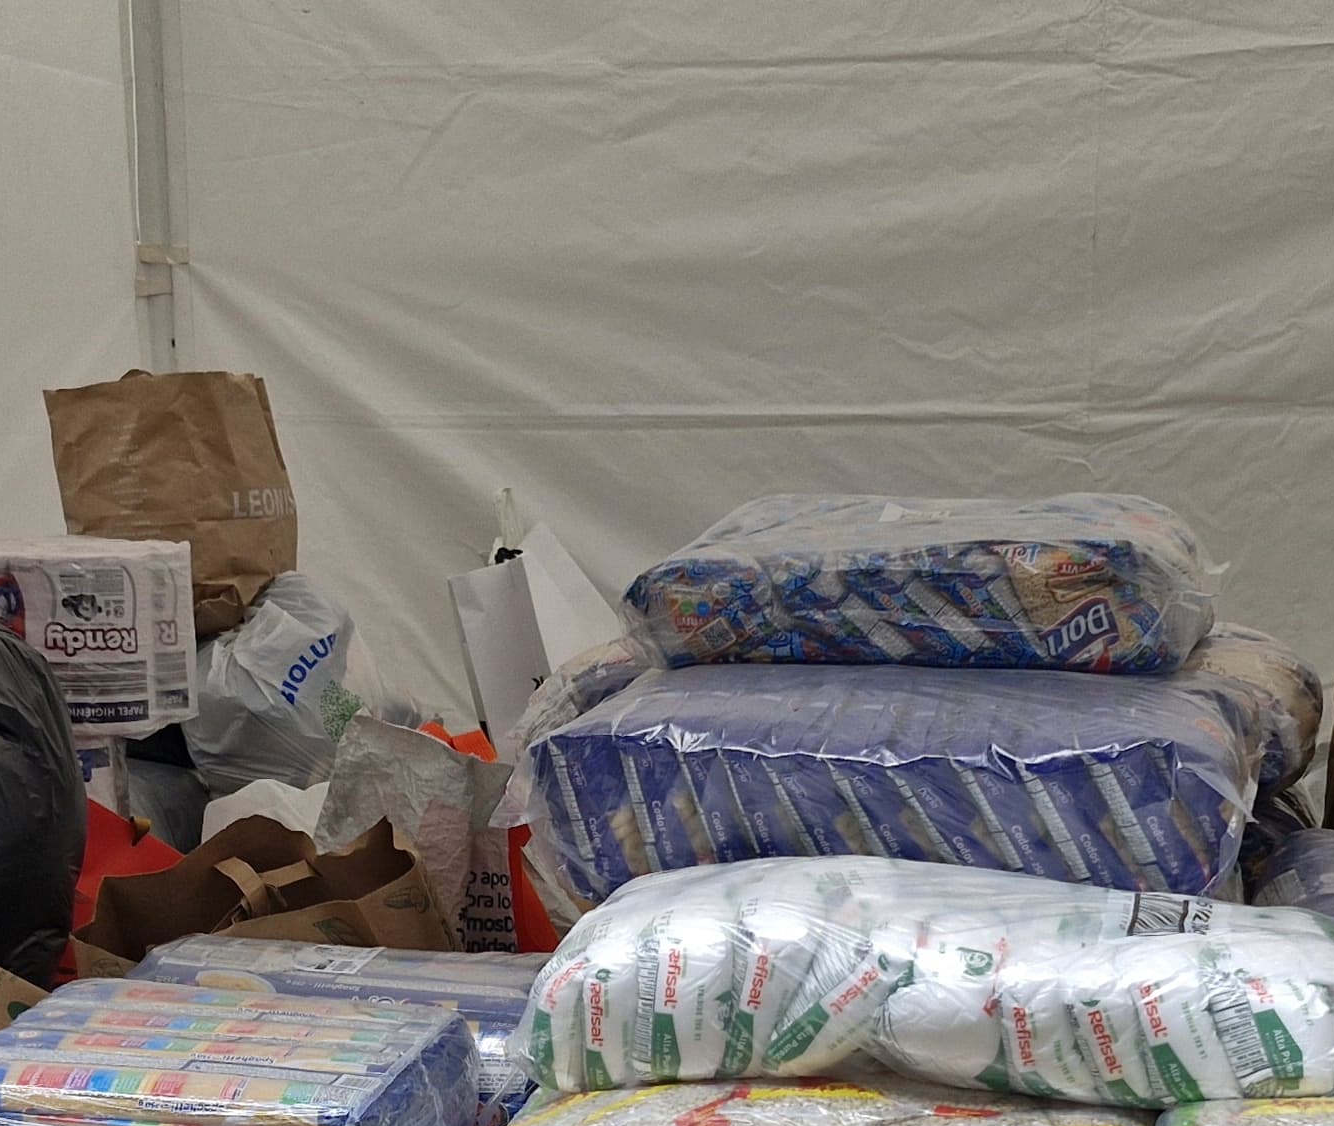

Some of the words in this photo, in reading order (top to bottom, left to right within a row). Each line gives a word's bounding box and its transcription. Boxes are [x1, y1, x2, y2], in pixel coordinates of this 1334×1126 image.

[45, 622, 138, 657] Rendy
[118, 704, 144, 715] PAPEL
[1011, 825, 1031, 859] Codos
[588, 982, 604, 1047] Refisal
[1012, 1007, 1035, 1068] Refisal
[1087, 1009, 1123, 1075] Refisal
